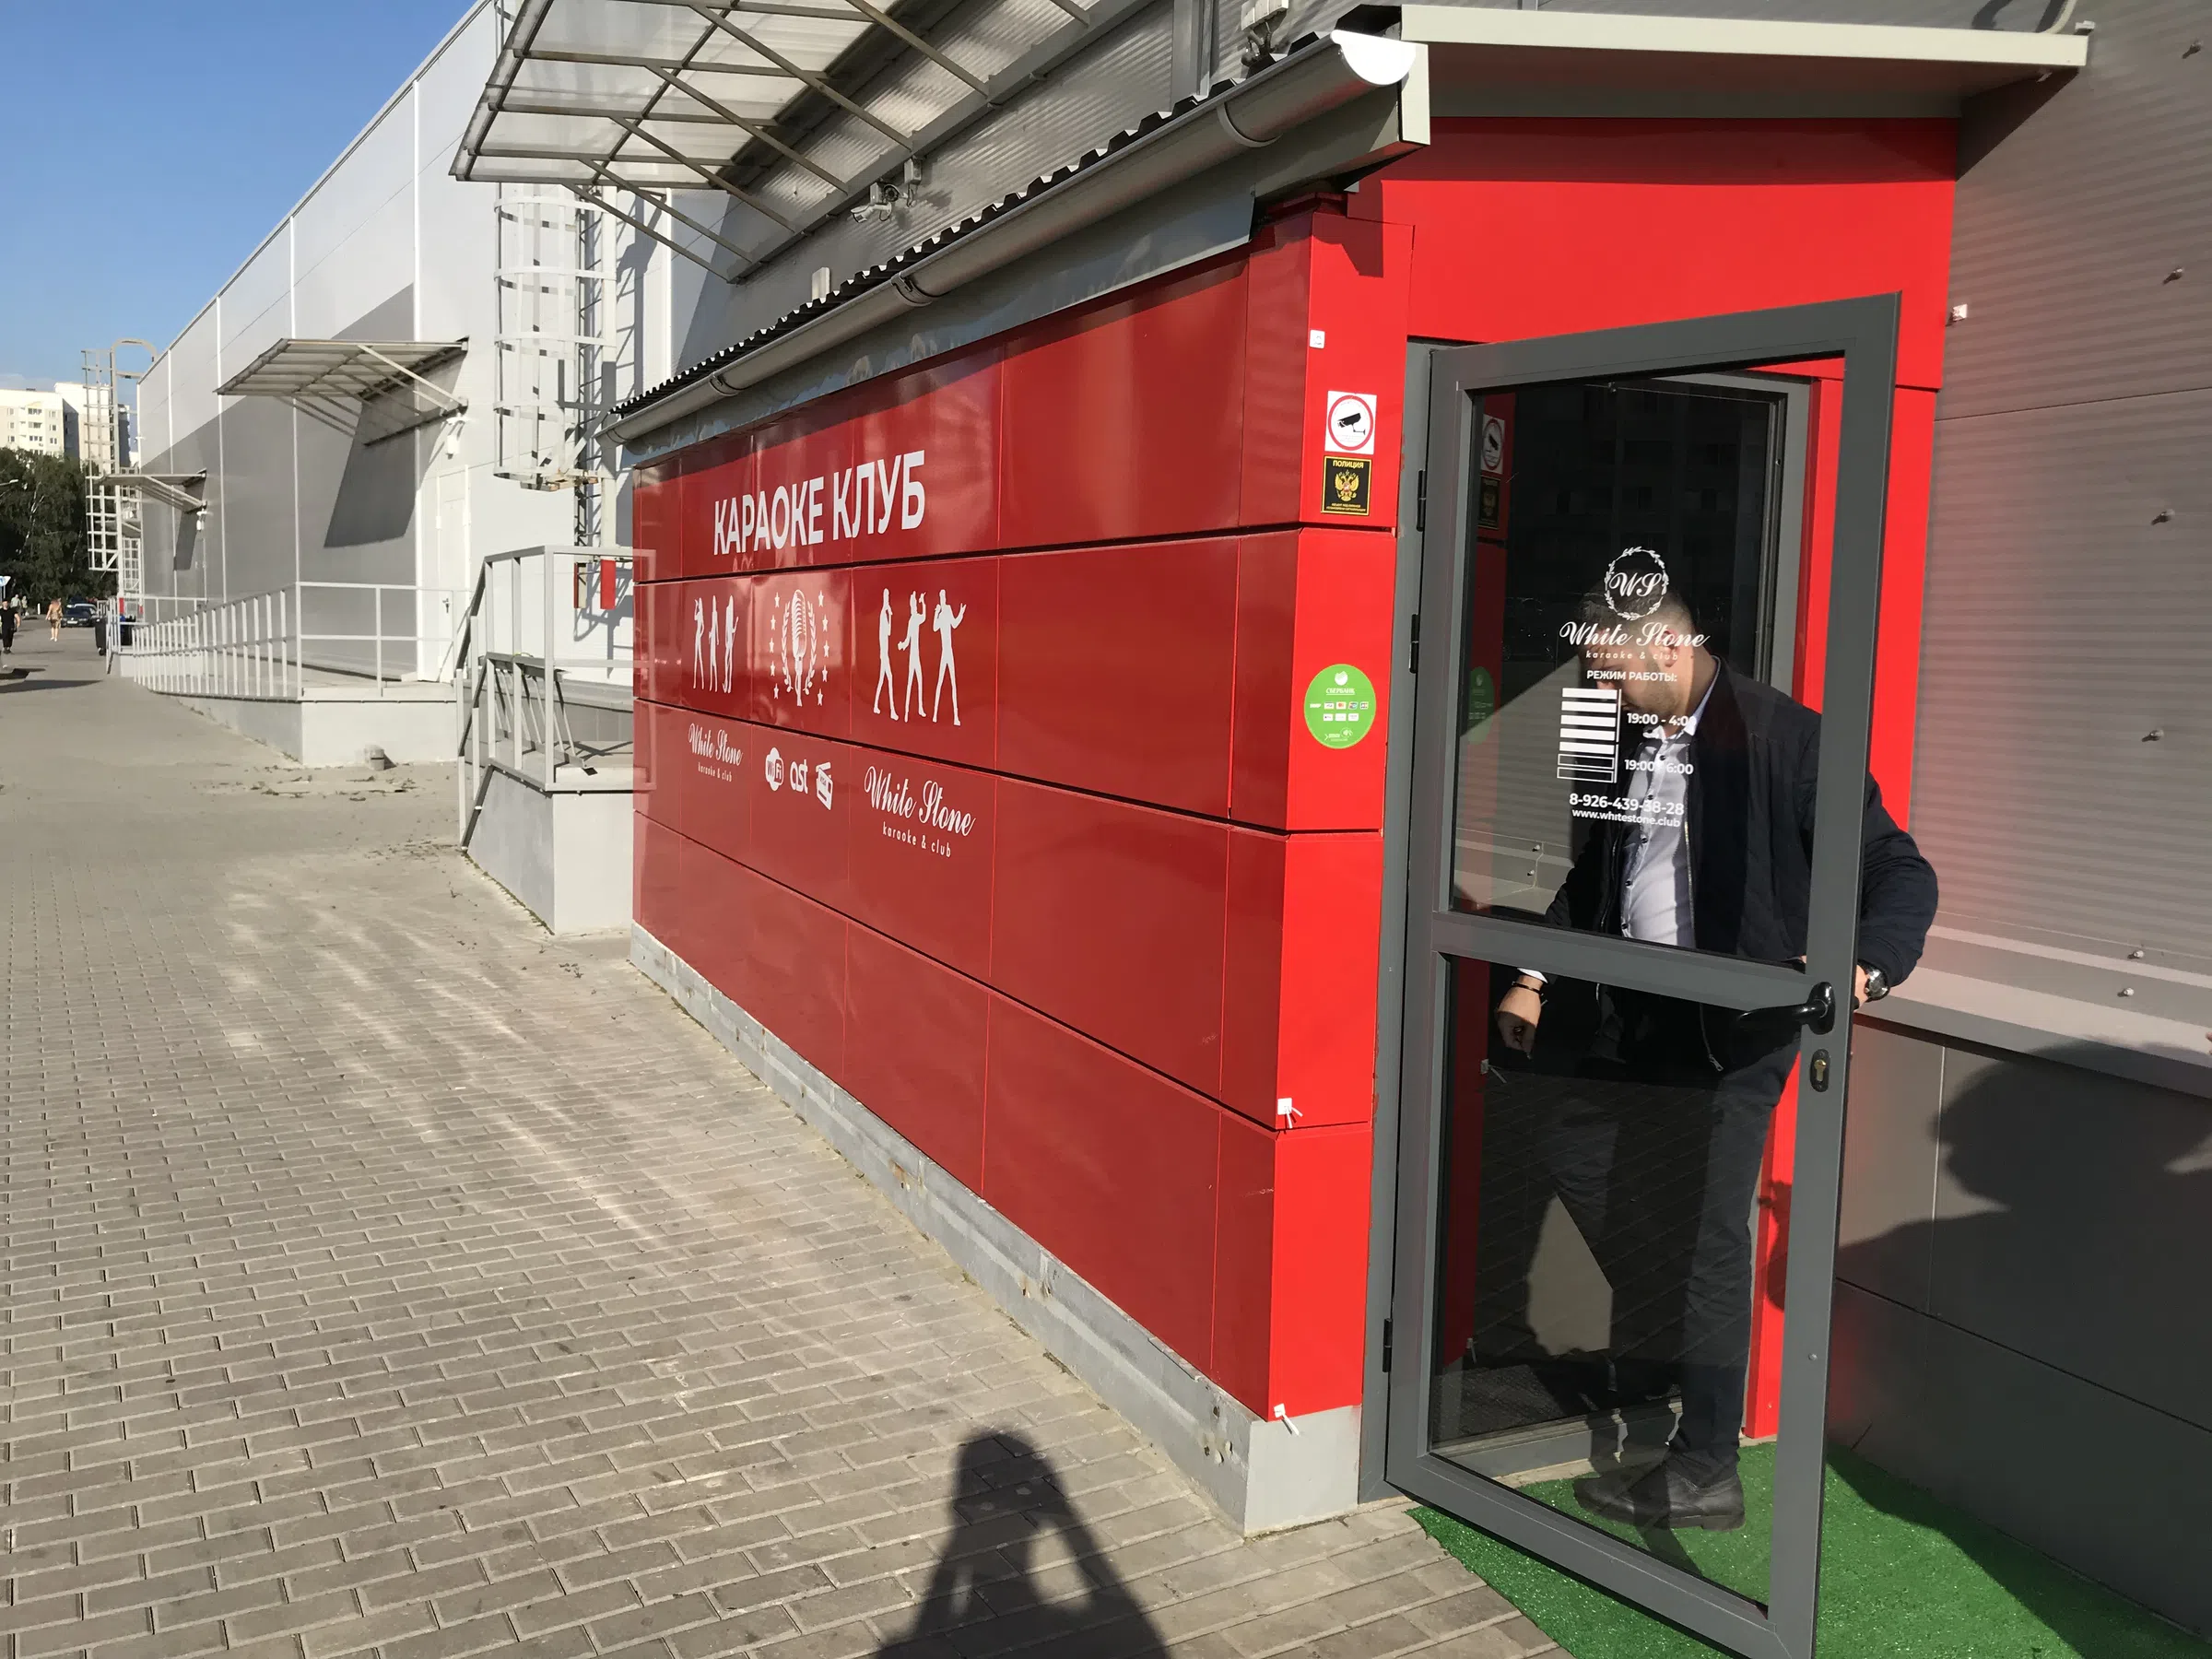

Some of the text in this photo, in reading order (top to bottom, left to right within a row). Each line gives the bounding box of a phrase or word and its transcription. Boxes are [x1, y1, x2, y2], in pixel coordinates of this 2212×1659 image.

[1332, 459, 1364, 469] ПОЛИЦИЯ
[713, 449, 925, 556] КАРАОКЕ КЛУБ
[1608, 571, 1663, 597] WS
[1559, 621, 1711, 648] White Stone
[1585, 650, 1678, 661] karaoke & club
[1586, 670, 1677, 682] РЕЖИМ РАБОТЫ:
[1627, 712, 1658, 725] 19:00
[688, 723, 744, 766] White Stone
[698, 761, 716, 777] karaoke
[722, 770, 733, 782] club
[1624, 759, 1694, 775] 19:00 6:00
[864, 765, 977, 837] White Stone
[1569, 793, 1685, 816] 8-926-439-38-28
[1571, 808, 1681, 828] www.whitestone.club
[882, 820, 951, 858] karaoke & club
